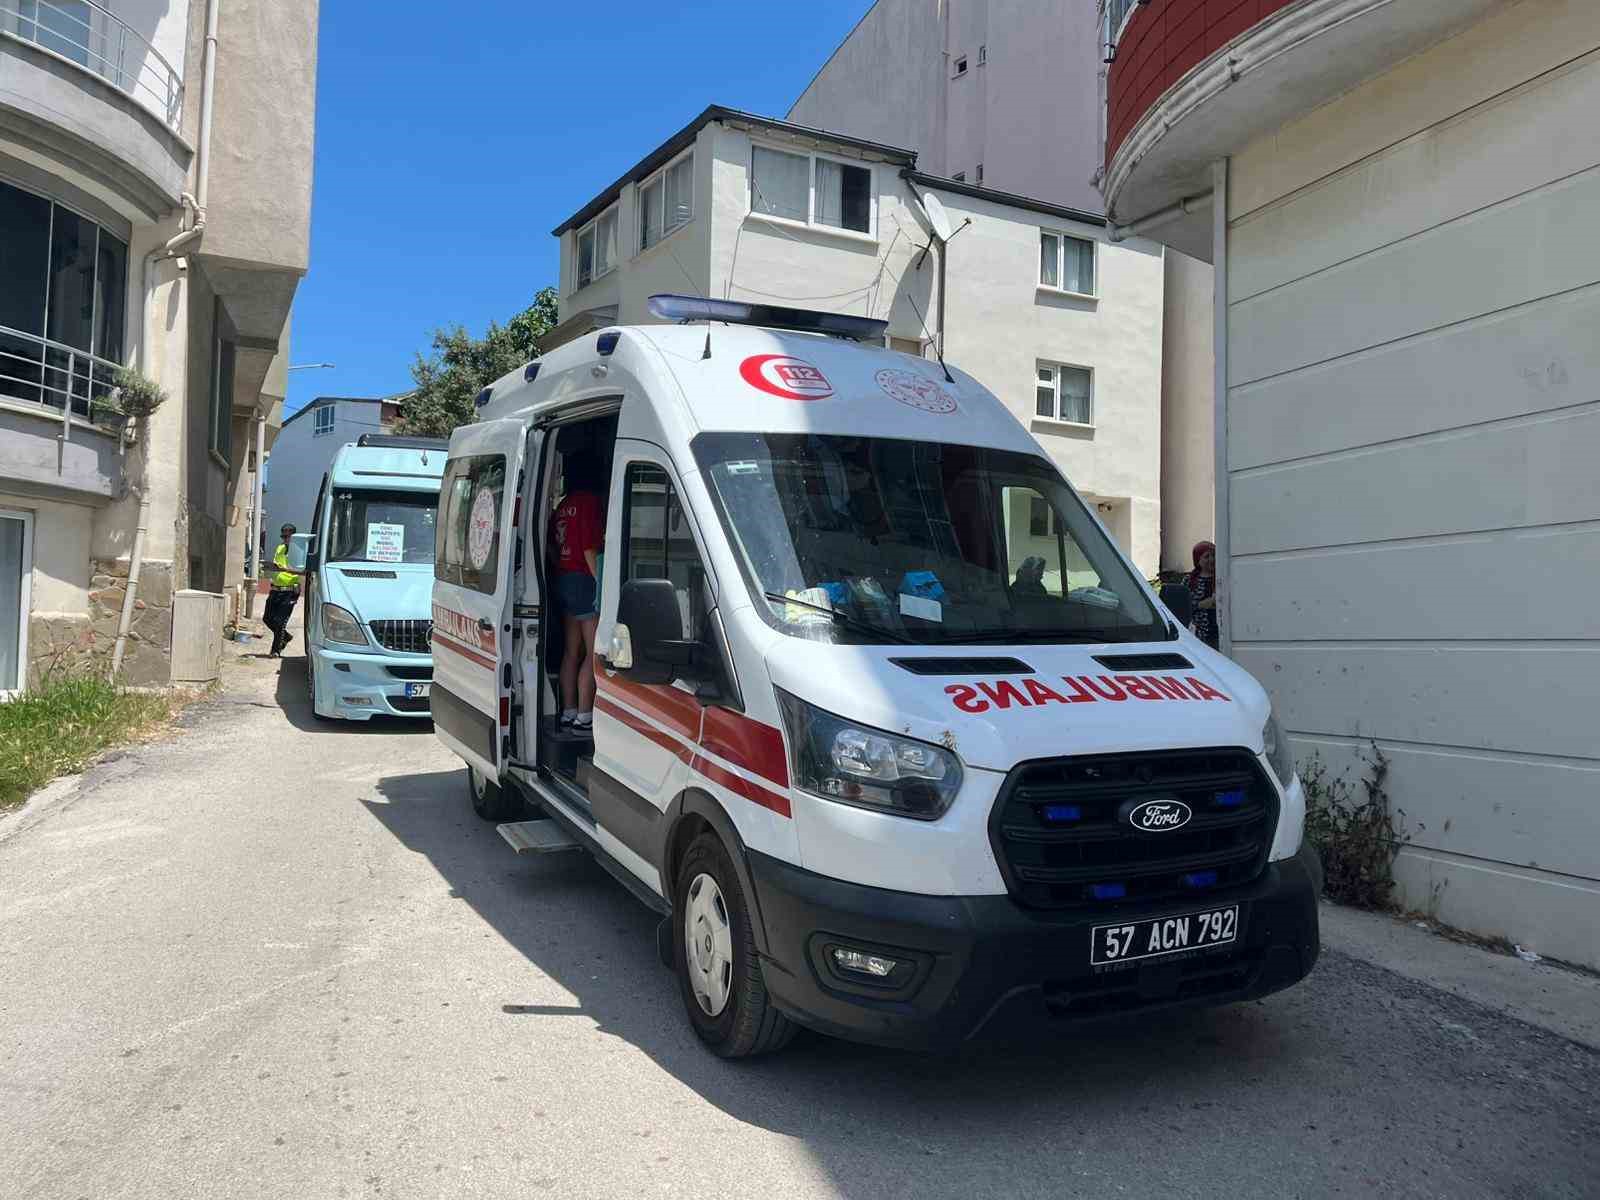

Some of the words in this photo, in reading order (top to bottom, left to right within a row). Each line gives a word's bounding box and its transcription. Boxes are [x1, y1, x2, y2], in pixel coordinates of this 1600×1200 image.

[782, 367, 820, 380] 112
[433, 606, 481, 647] MBULANS
[412, 684, 424, 696] 57
[1142, 805, 1180, 827] Ford
[1105, 925, 1135, 959] 57
[1148, 917, 1190, 952] ACN
[1198, 909, 1235, 943] 792
